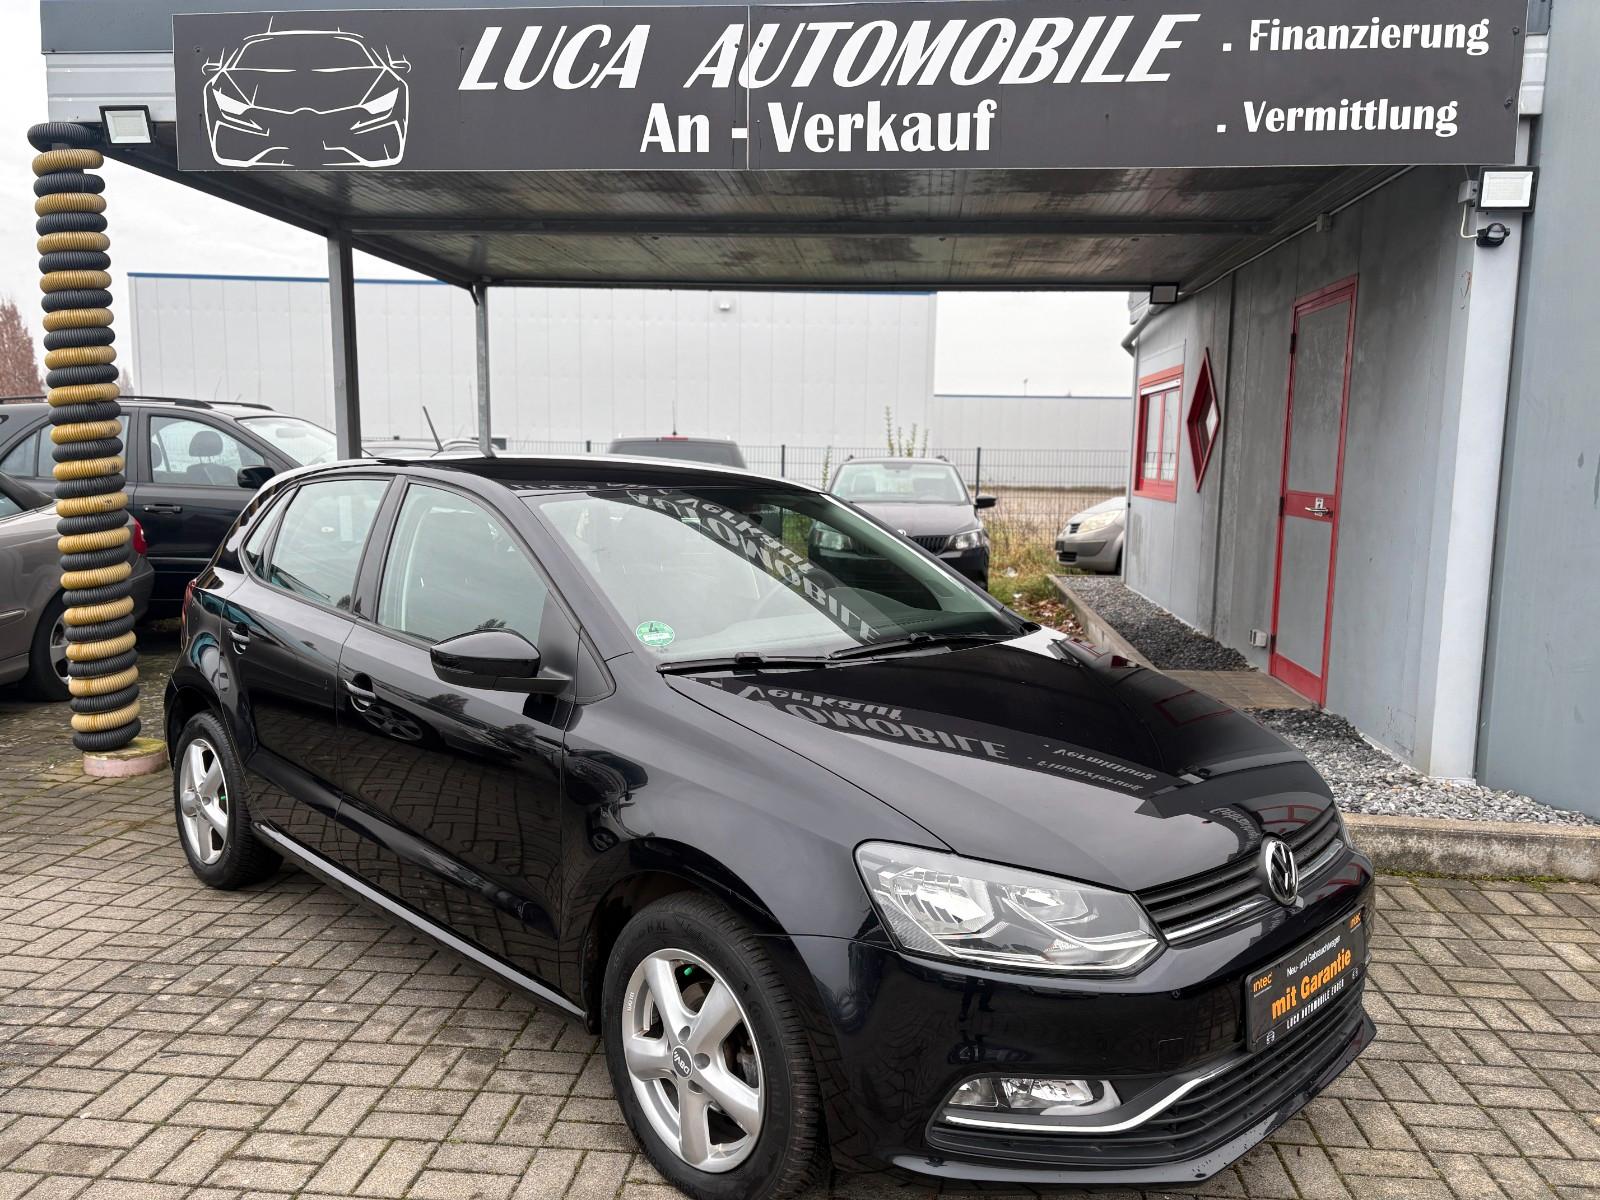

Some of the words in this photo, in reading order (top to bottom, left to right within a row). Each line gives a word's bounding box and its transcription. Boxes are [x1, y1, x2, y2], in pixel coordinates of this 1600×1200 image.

[458, 24, 650, 91] LUCA
[683, 14, 1200, 89] AUTOMOBILE
[1250, 17, 1489, 56] Finanzierung
[640, 103, 709, 153] An
[768, 99, 997, 153] Verkauf
[1244, 99, 1458, 138] Vermittlung
[1272, 985, 1297, 1020] mit
[1301, 948, 1352, 1000] Garantie
